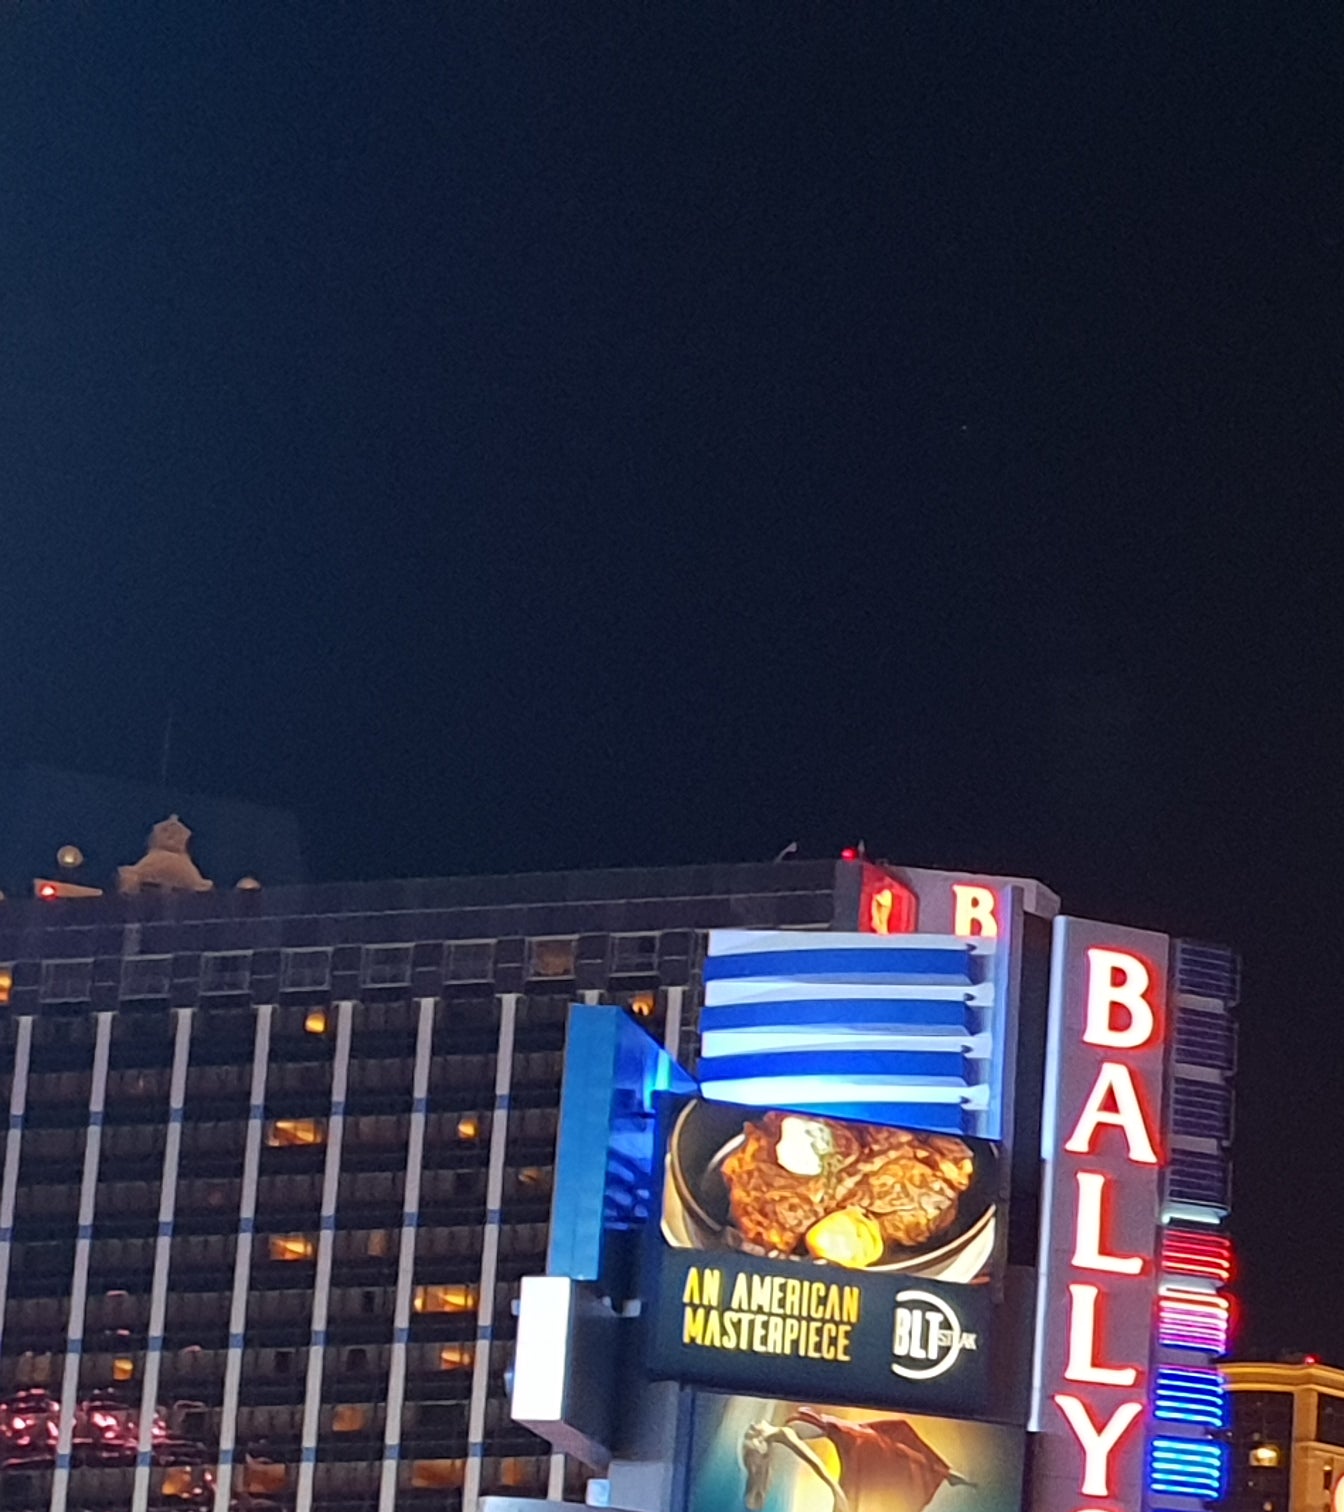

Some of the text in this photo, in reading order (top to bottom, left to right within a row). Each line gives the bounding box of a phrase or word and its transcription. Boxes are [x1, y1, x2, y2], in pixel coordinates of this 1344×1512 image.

[683, 1266, 860, 1324] AN AMERICAN
[683, 1307, 852, 1361] MASTERPIECE
[892, 1307, 944, 1361] BLT
[938, 1329, 977, 1350] STAK
